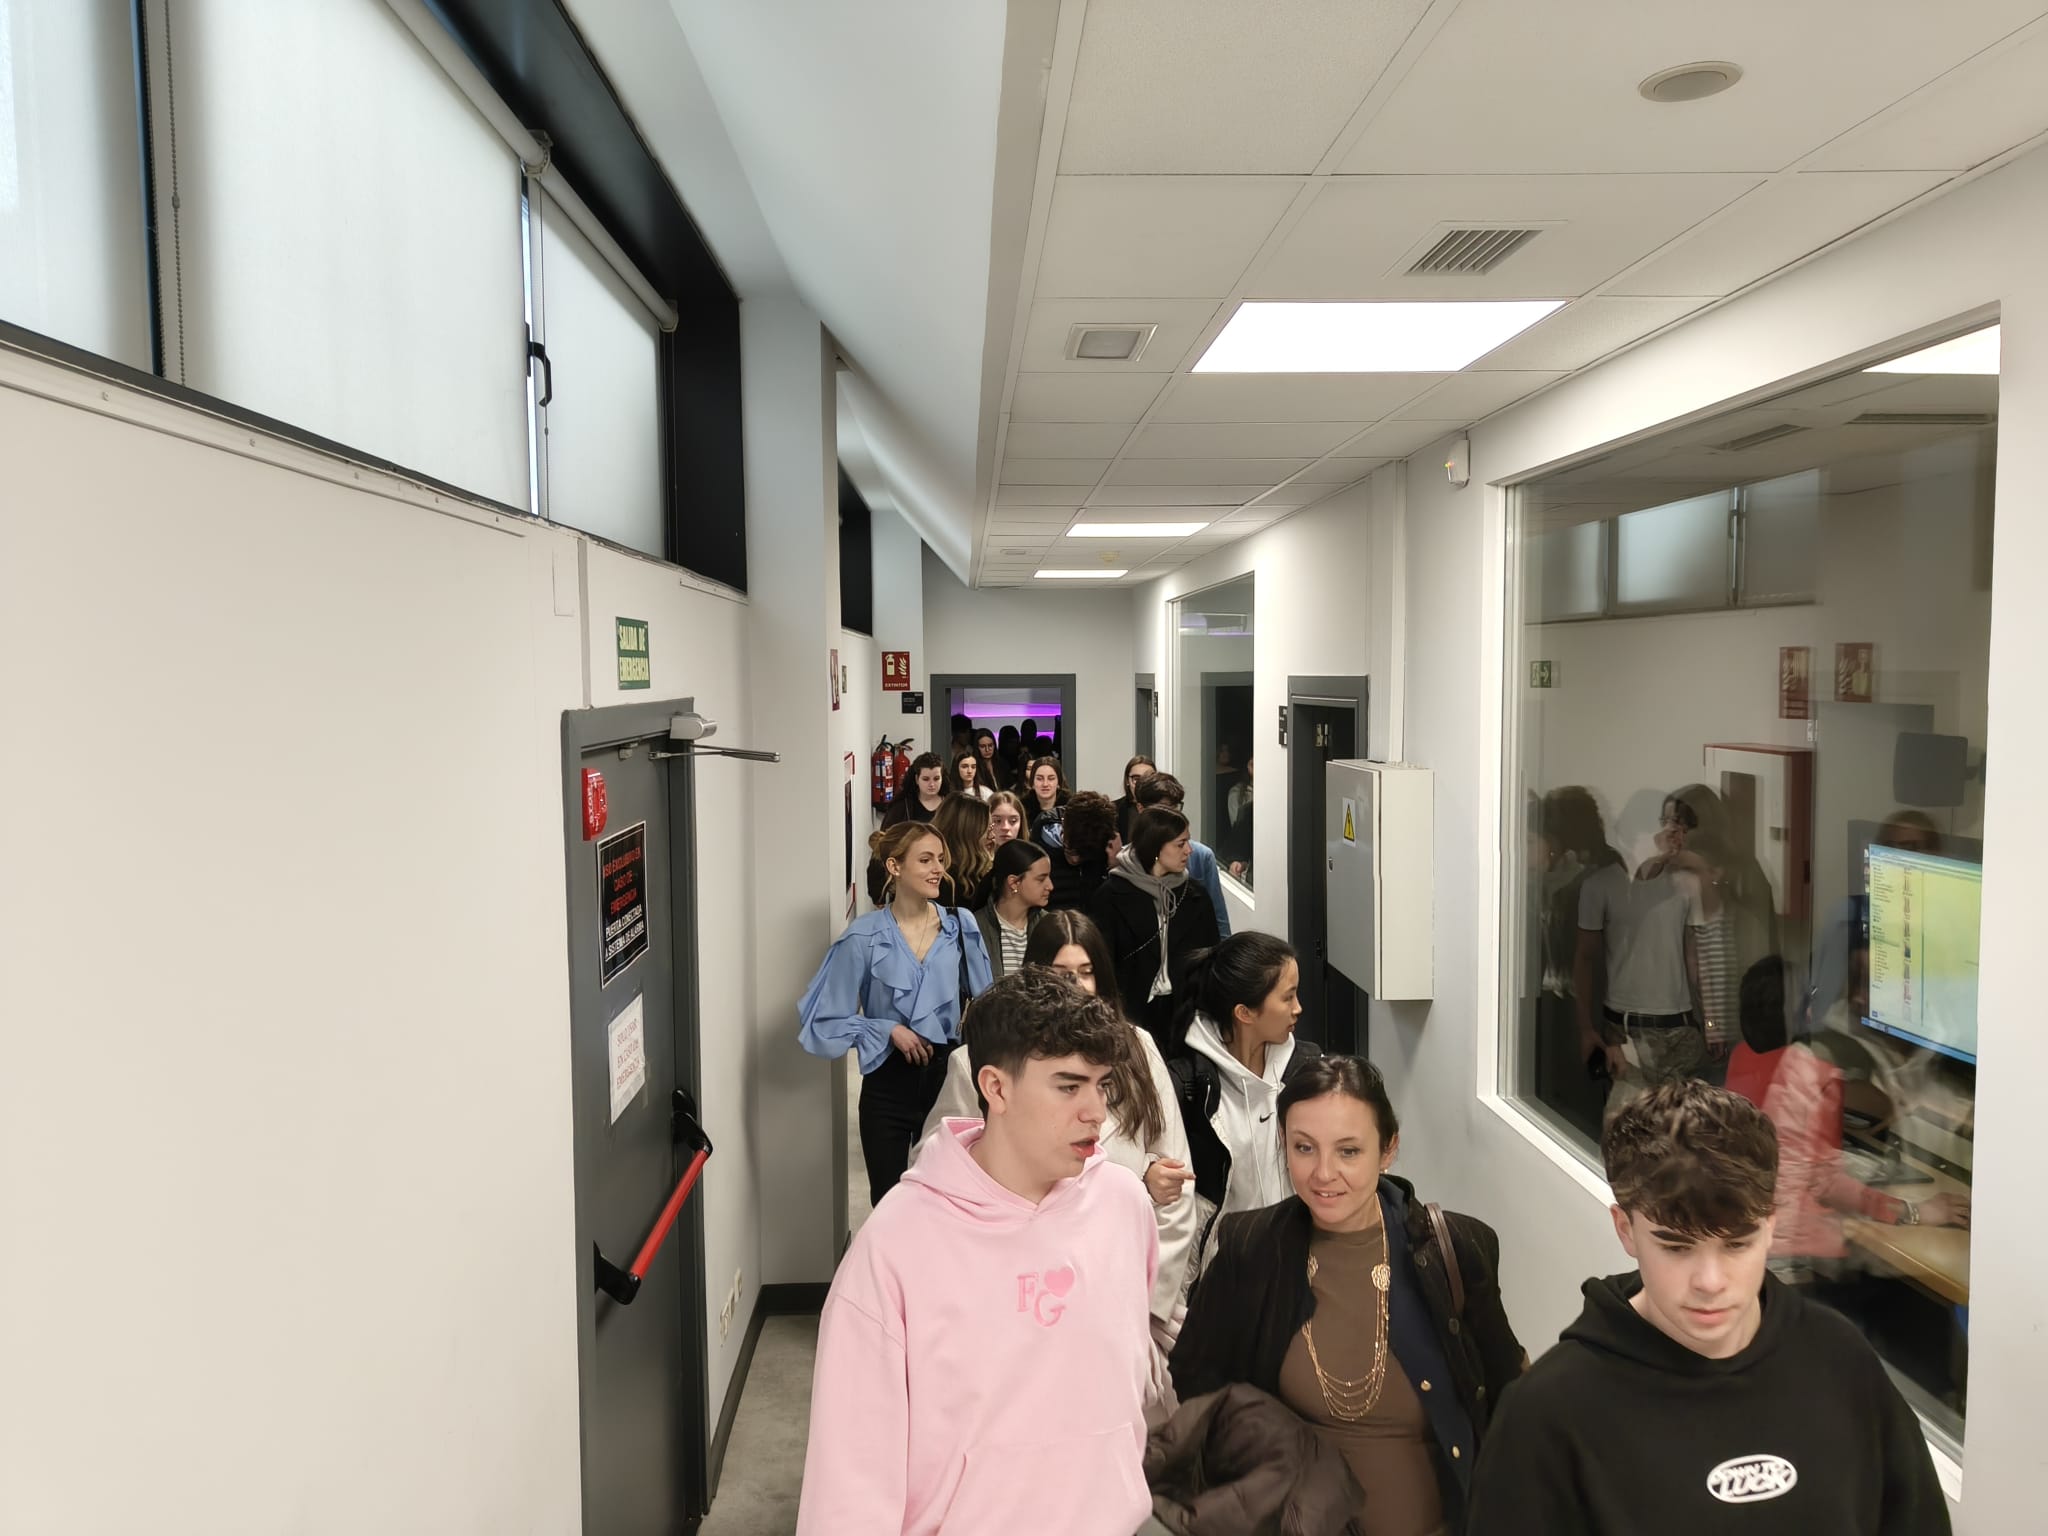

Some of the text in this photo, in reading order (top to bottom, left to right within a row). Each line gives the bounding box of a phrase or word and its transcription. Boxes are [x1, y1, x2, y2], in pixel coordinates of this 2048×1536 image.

[619, 624, 646, 651] SALIDA DE
[619, 656, 650, 681] EMERGENCIA
[610, 888, 638, 915] EMERGENCIA
[605, 904, 643, 938] PUERTA CONECTADA
[608, 935, 626, 956] SISTEMA
[631, 920, 645, 938] ALARMA
